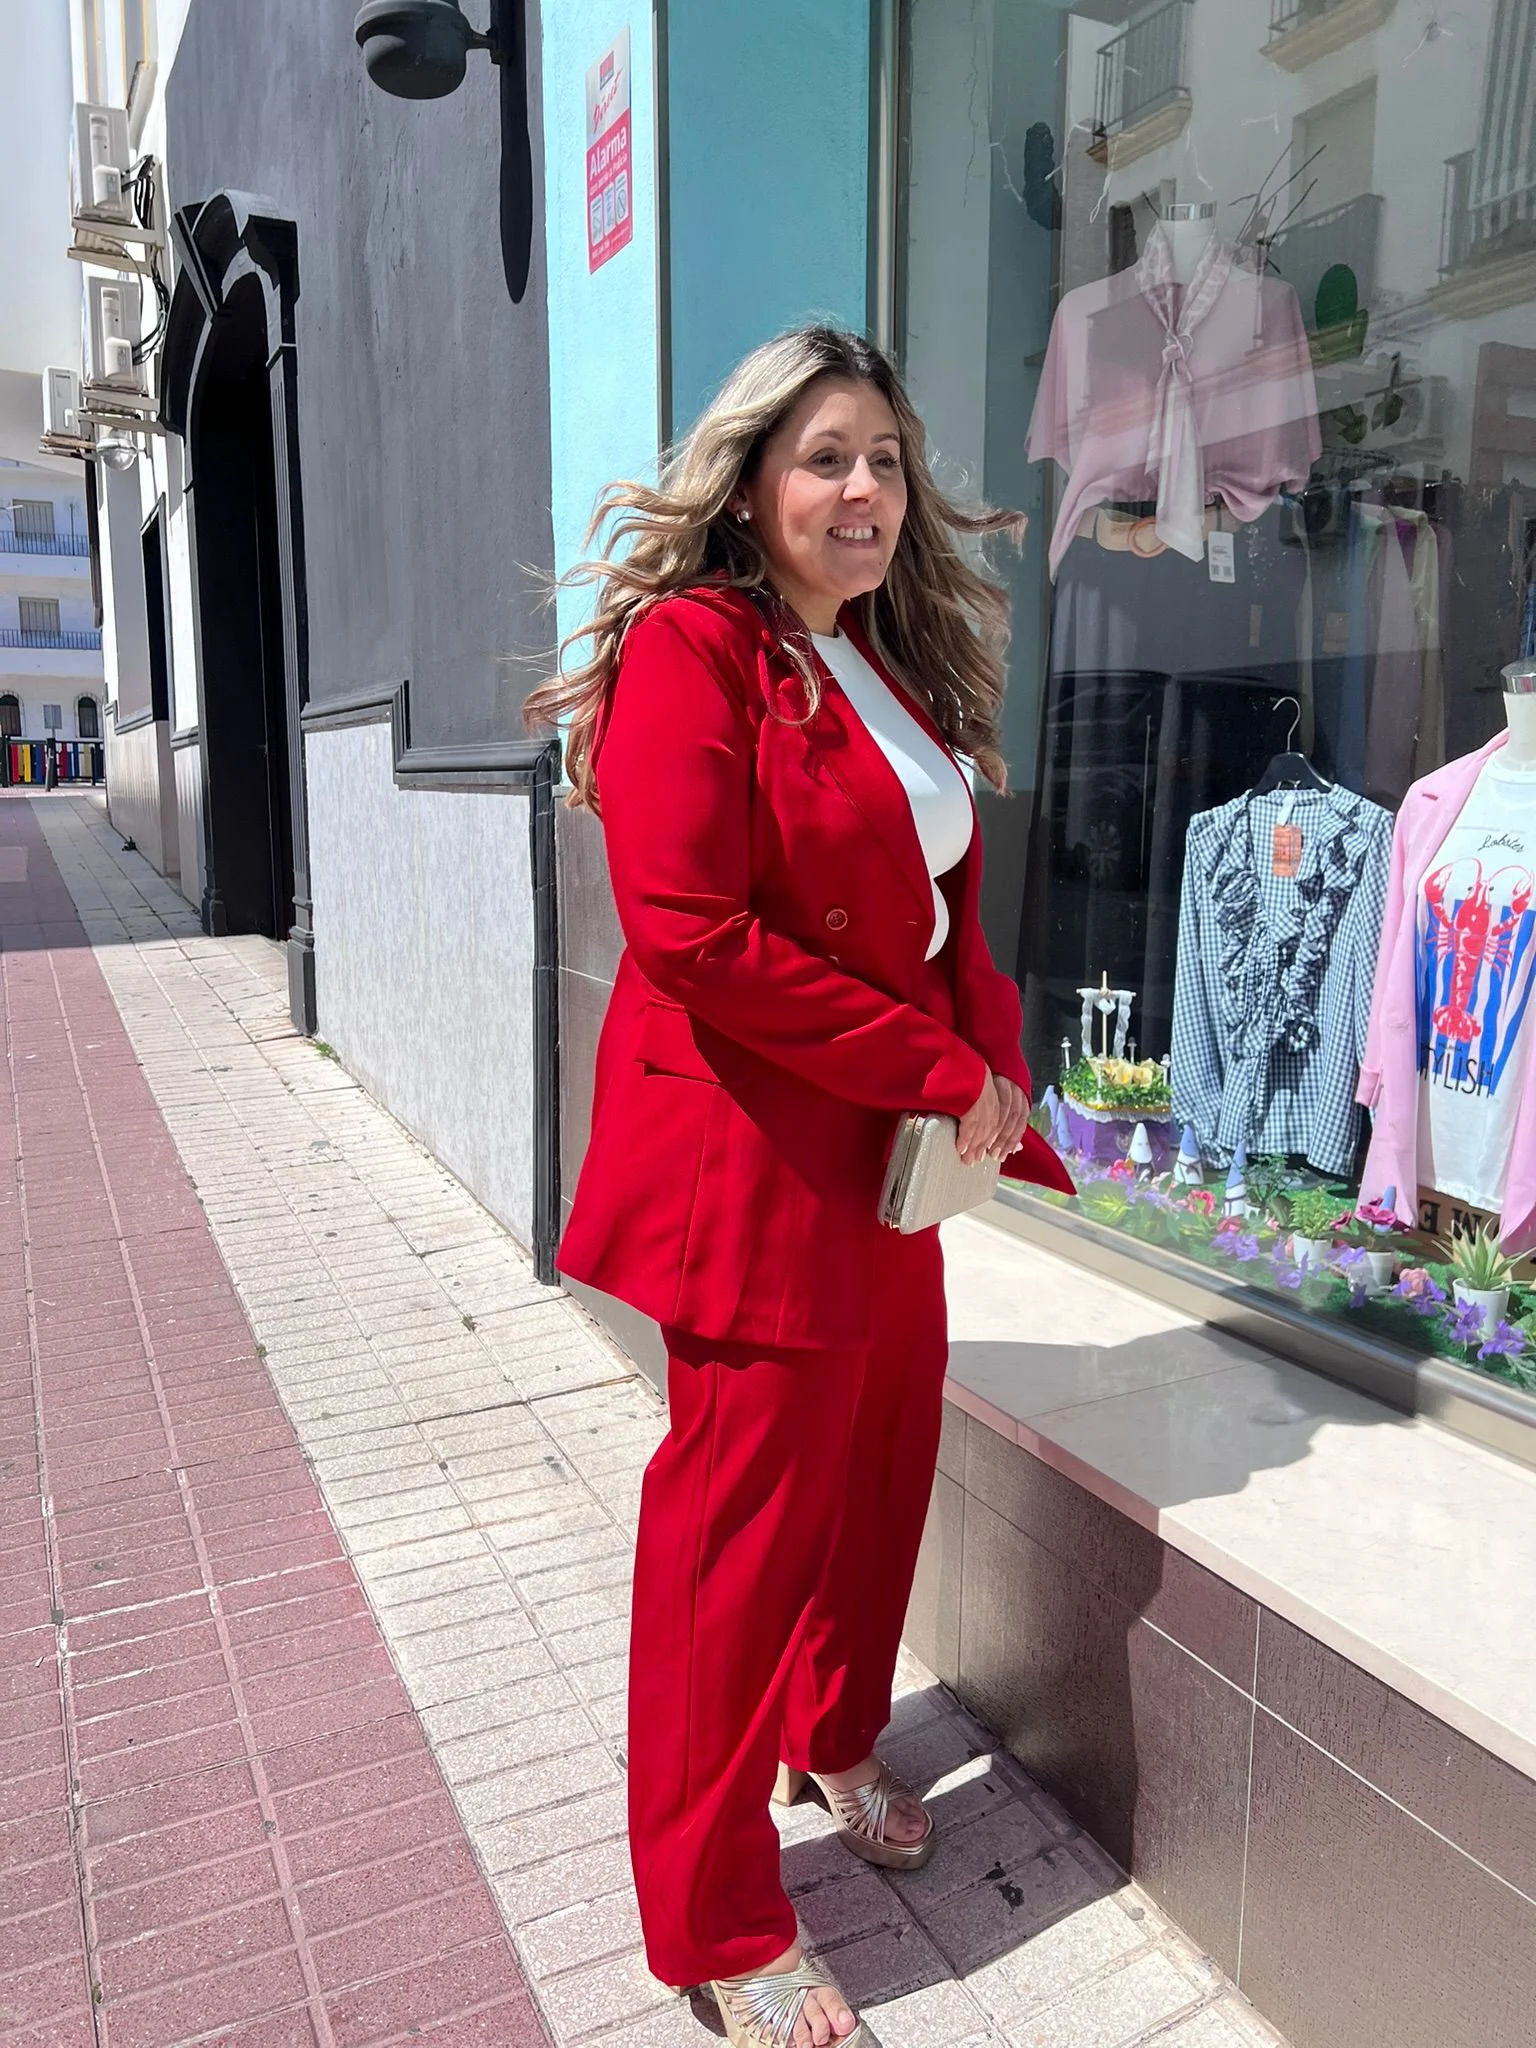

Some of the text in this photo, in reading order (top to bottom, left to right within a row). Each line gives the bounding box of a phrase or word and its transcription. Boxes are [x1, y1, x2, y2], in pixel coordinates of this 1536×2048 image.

[590, 126, 627, 181] Alarma
[1477, 833, 1525, 853] Lobster
[1419, 1045, 1494, 1099] TYLISH
